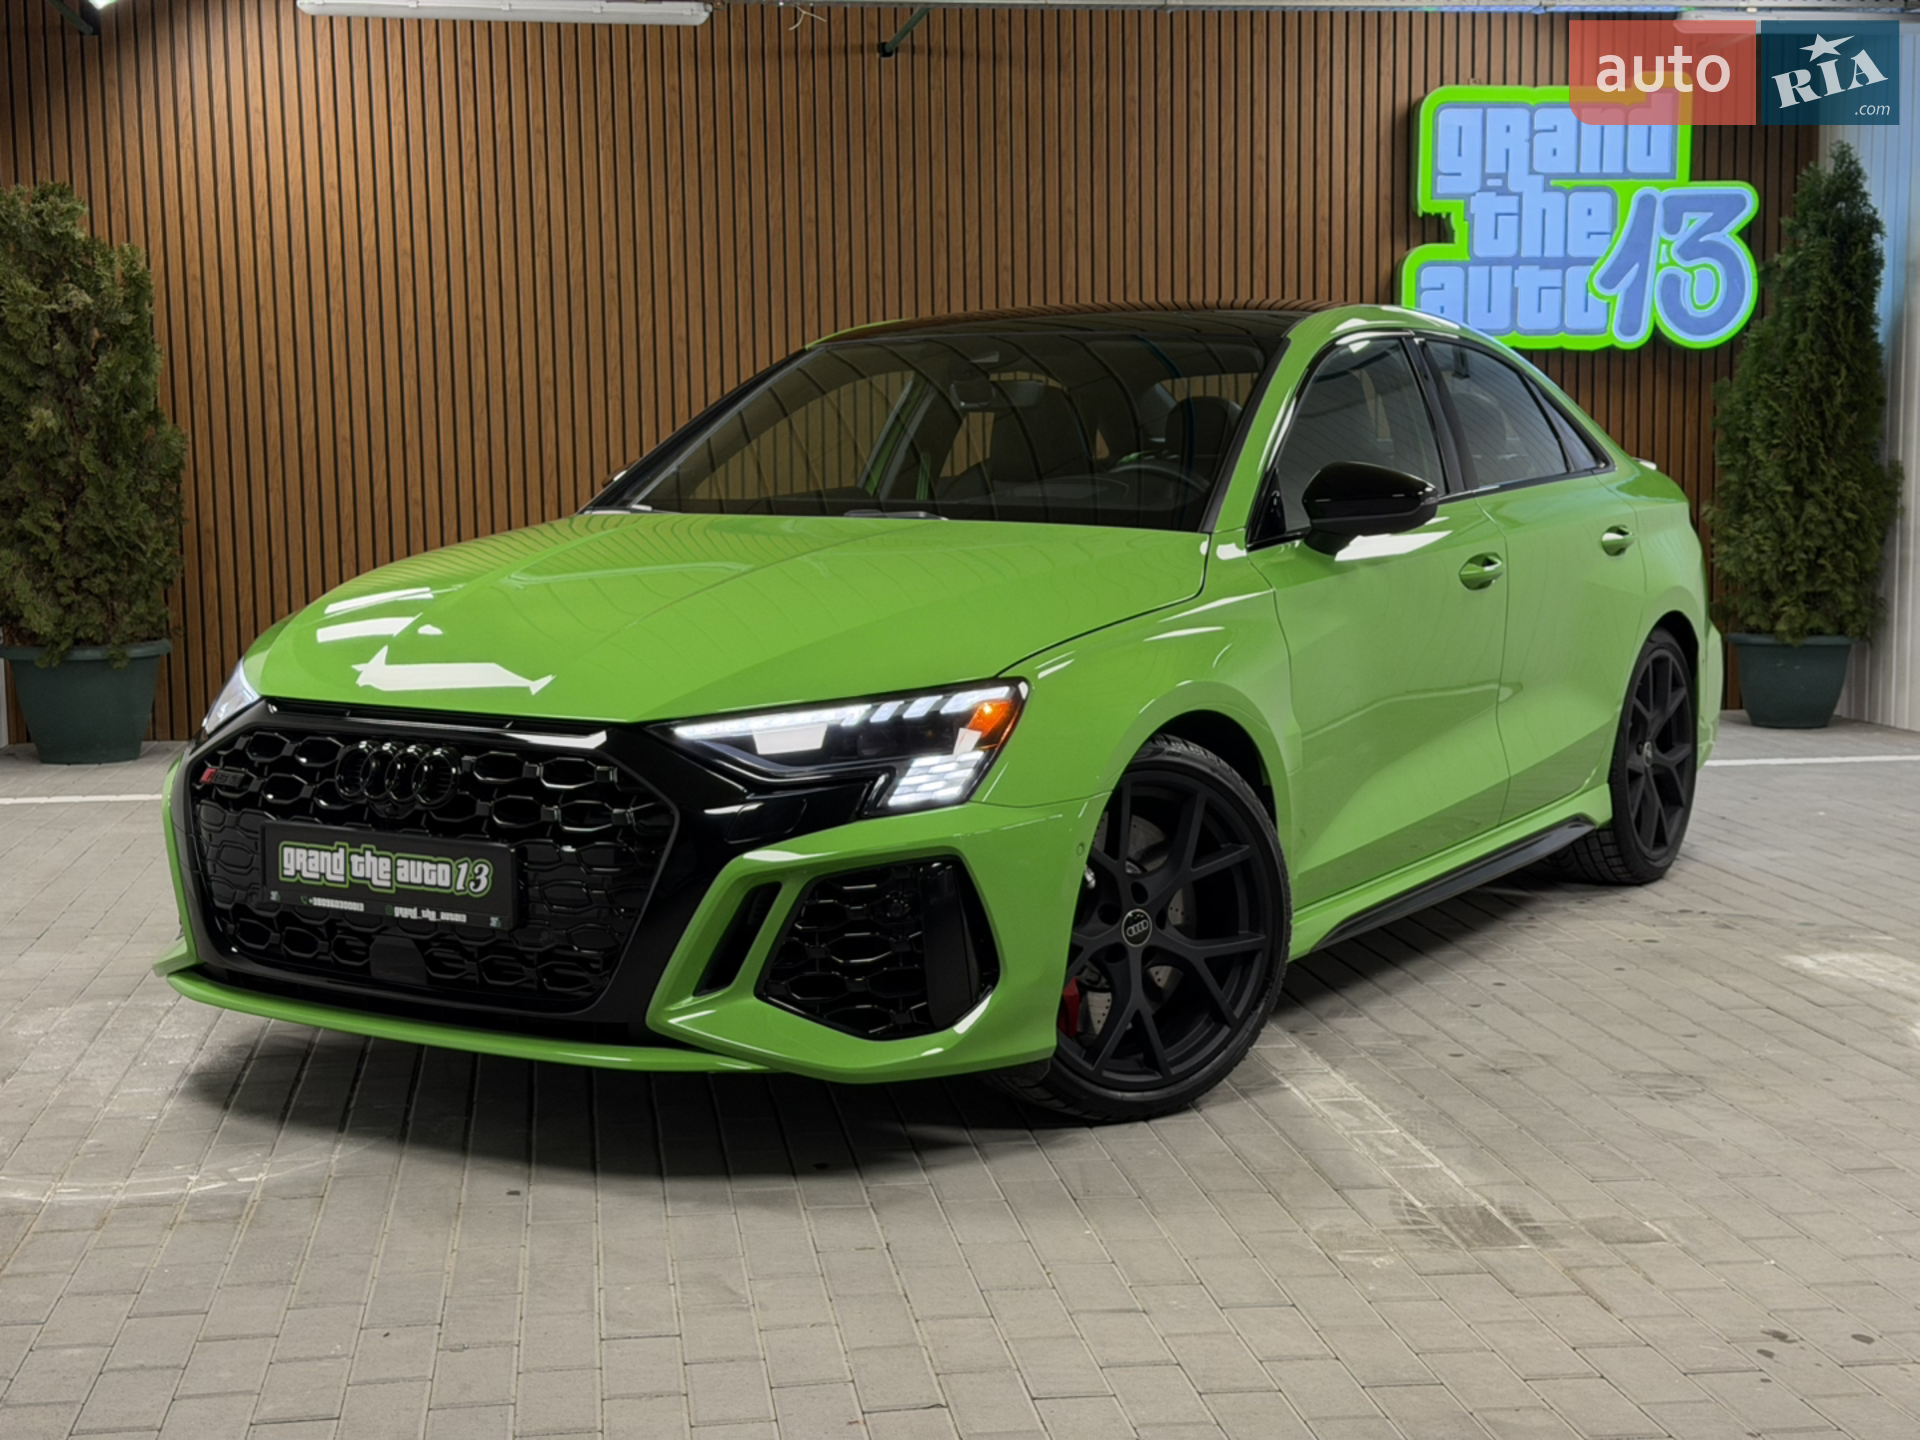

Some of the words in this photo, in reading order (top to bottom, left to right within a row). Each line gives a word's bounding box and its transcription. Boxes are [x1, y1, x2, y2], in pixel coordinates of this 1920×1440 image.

[1436, 91, 1674, 194] grand
[1470, 183, 1613, 258] the
[1420, 264, 1609, 330] auto
[1593, 187, 1758, 343] 13
[283, 846, 345, 882] grand
[350, 850, 391, 887] the
